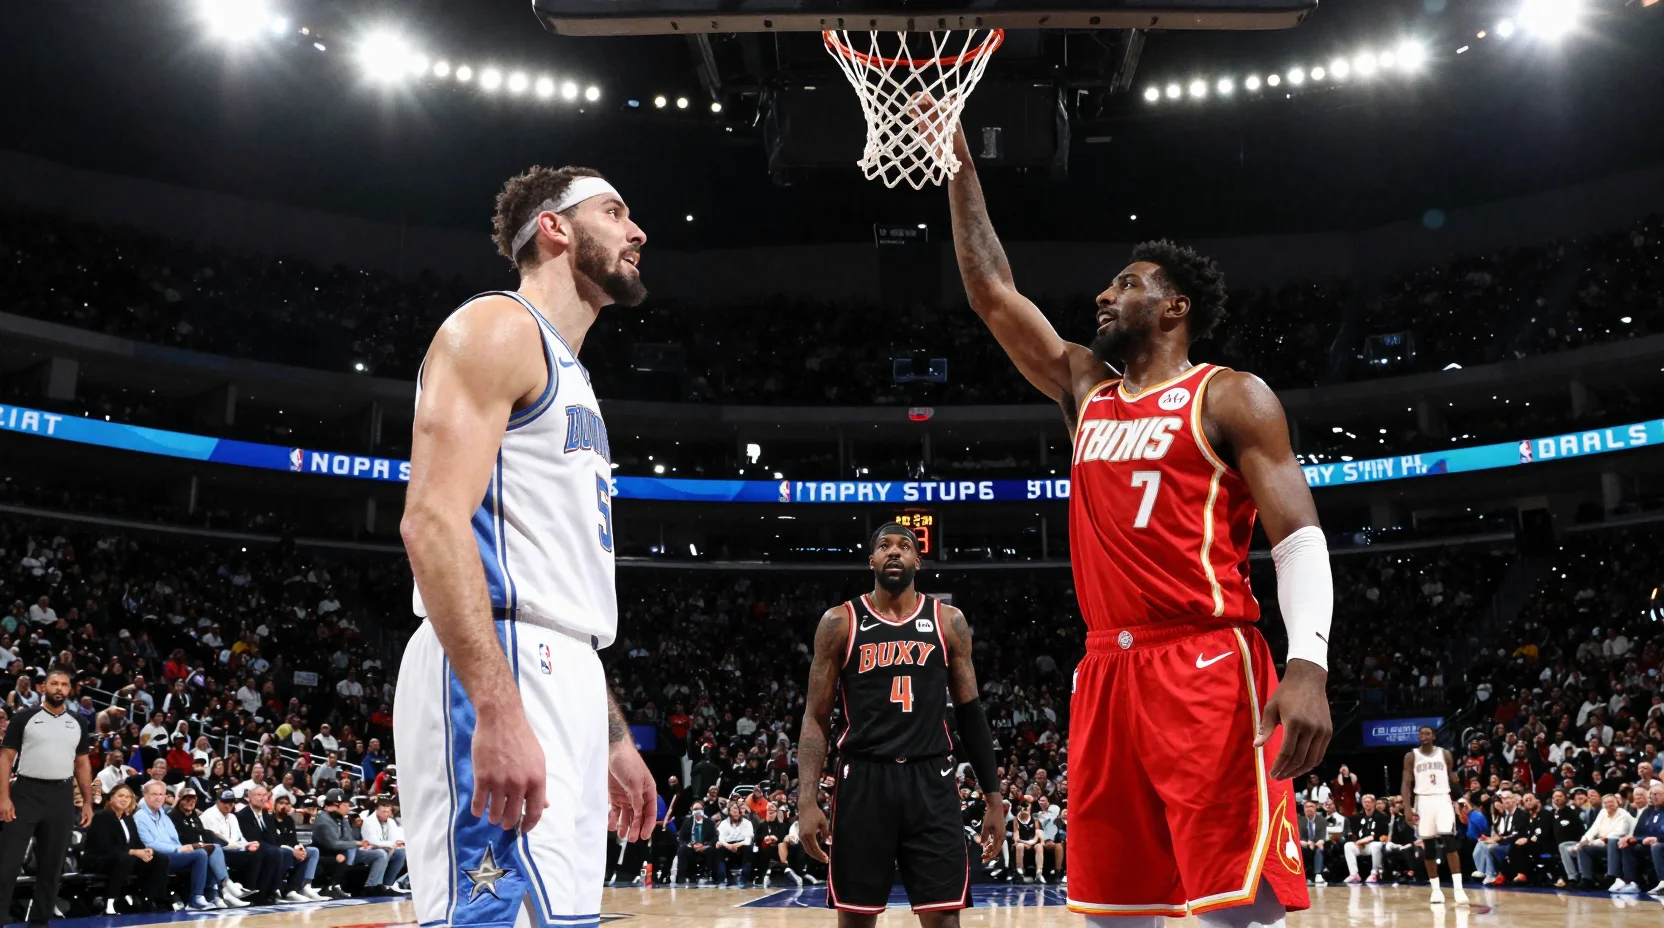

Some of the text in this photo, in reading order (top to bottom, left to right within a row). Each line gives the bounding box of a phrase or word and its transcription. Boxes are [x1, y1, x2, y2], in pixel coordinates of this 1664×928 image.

[1131, 470, 1162, 528] 7
[858, 640, 935, 674] BUXY
[890, 676, 914, 713] 4
